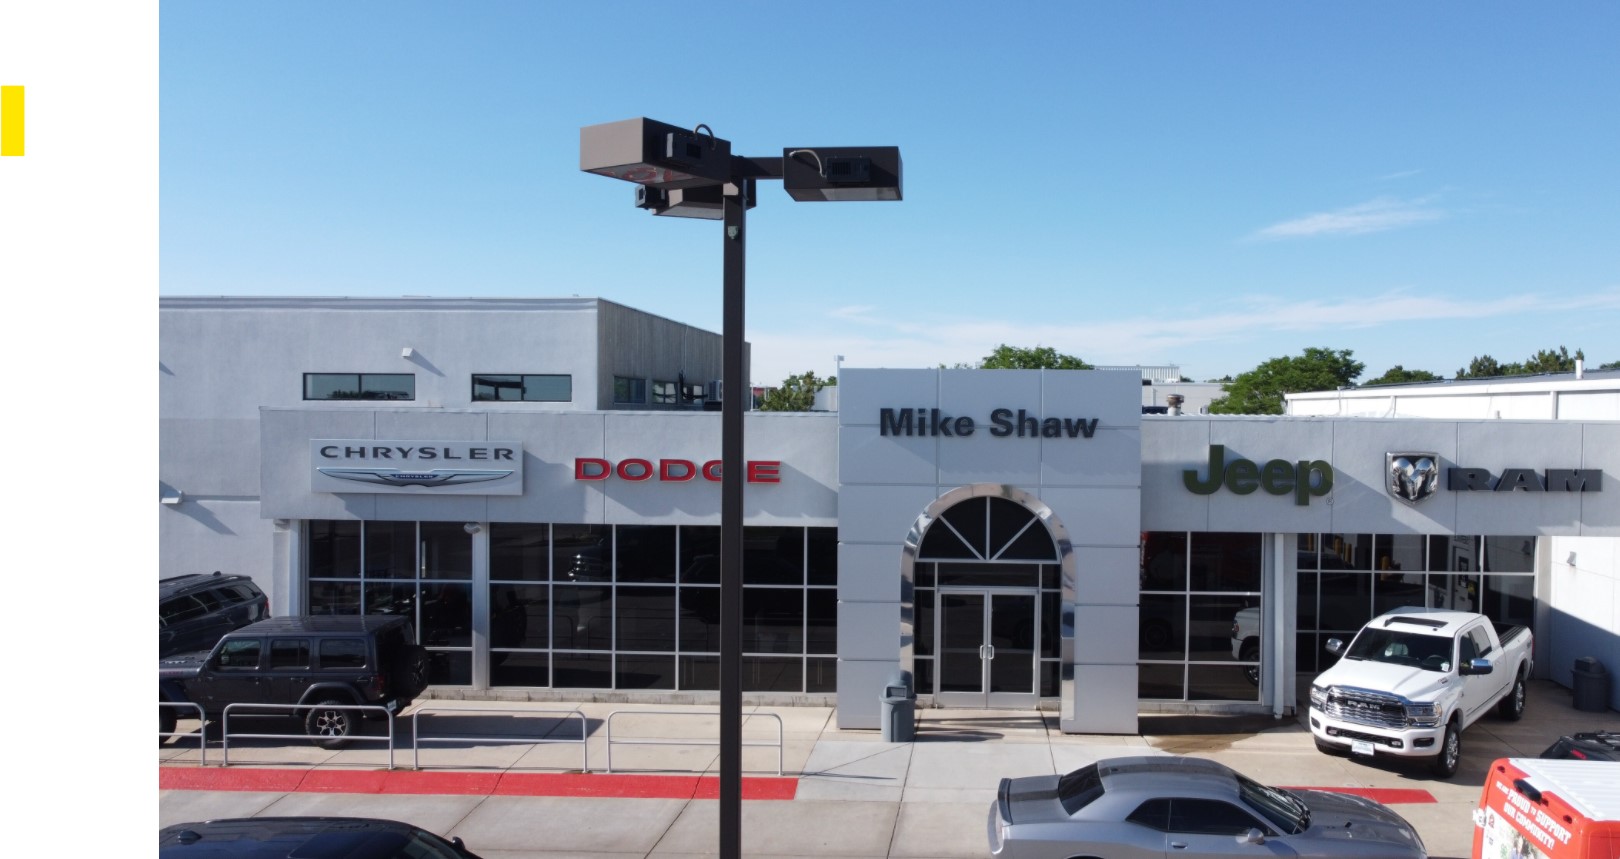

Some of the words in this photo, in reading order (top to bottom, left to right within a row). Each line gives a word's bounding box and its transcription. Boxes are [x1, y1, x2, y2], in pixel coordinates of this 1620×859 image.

[880, 408, 975, 437] Mike
[990, 408, 1099, 438] Shaw
[320, 445, 515, 461] CHRYSLER
[1183, 445, 1334, 506] Jeep
[1448, 468, 1603, 492] RAM
[1347, 700, 1380, 710] RAM
[1503, 801, 1516, 819] OUR
[1515, 811, 1555, 850] COMMUNITY!
[1508, 788, 1531, 814] PROUD
[1536, 809, 1572, 845] SUPPORT
